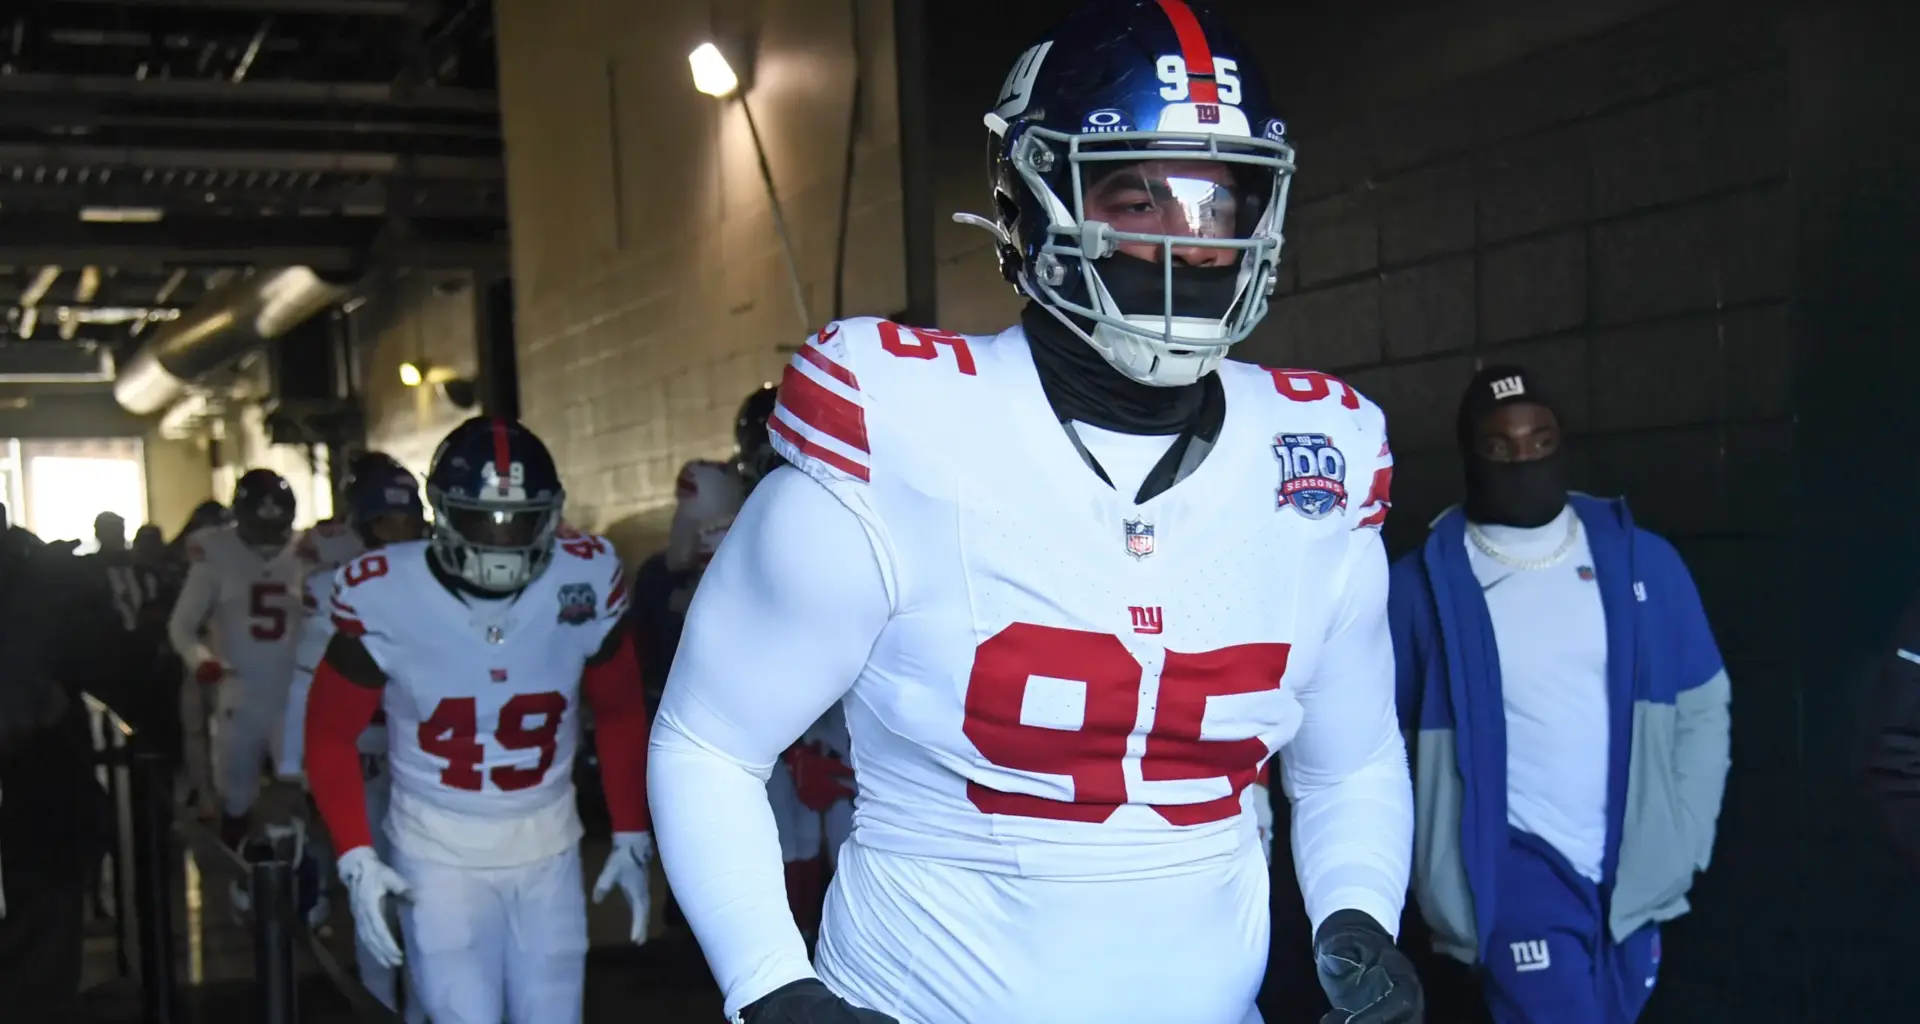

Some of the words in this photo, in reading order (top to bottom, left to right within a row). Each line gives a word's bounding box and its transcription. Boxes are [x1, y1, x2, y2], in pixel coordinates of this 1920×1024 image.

[1156, 55, 1242, 105] 95
[877, 320, 977, 376] 5
[1261, 367, 1360, 410] 9
[1490, 375, 1525, 400] ny
[1274, 446, 1346, 482] 100
[1286, 479, 1341, 493] SEASONS
[344, 554, 390, 587] 9
[250, 583, 287, 641] 5
[1127, 606, 1164, 634] ny
[418, 690, 567, 792] 49
[962, 621, 1292, 827] 95
[1509, 939, 1551, 972] ny
